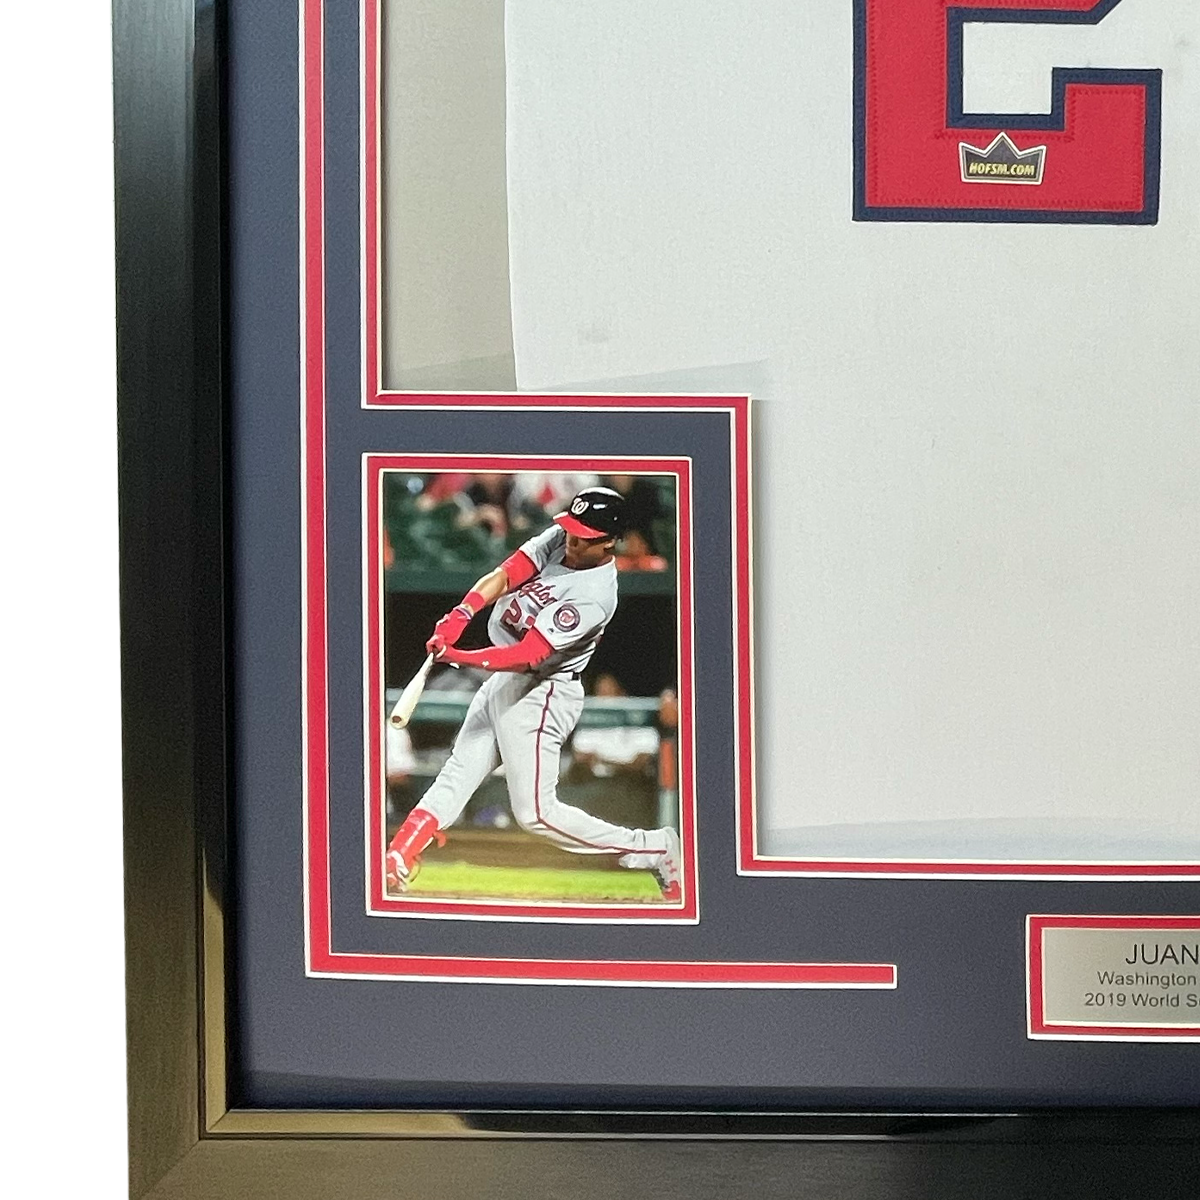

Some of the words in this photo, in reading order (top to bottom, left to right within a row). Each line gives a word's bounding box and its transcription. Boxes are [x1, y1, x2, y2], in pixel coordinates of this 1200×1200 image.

[968, 162, 1036, 176] HOFSM.COM
[1125, 943, 1200, 965] JUAN
[1096, 970, 1197, 990] Washington
[1084, 992, 1127, 1007] 2019
[1131, 992, 1180, 1008] World
